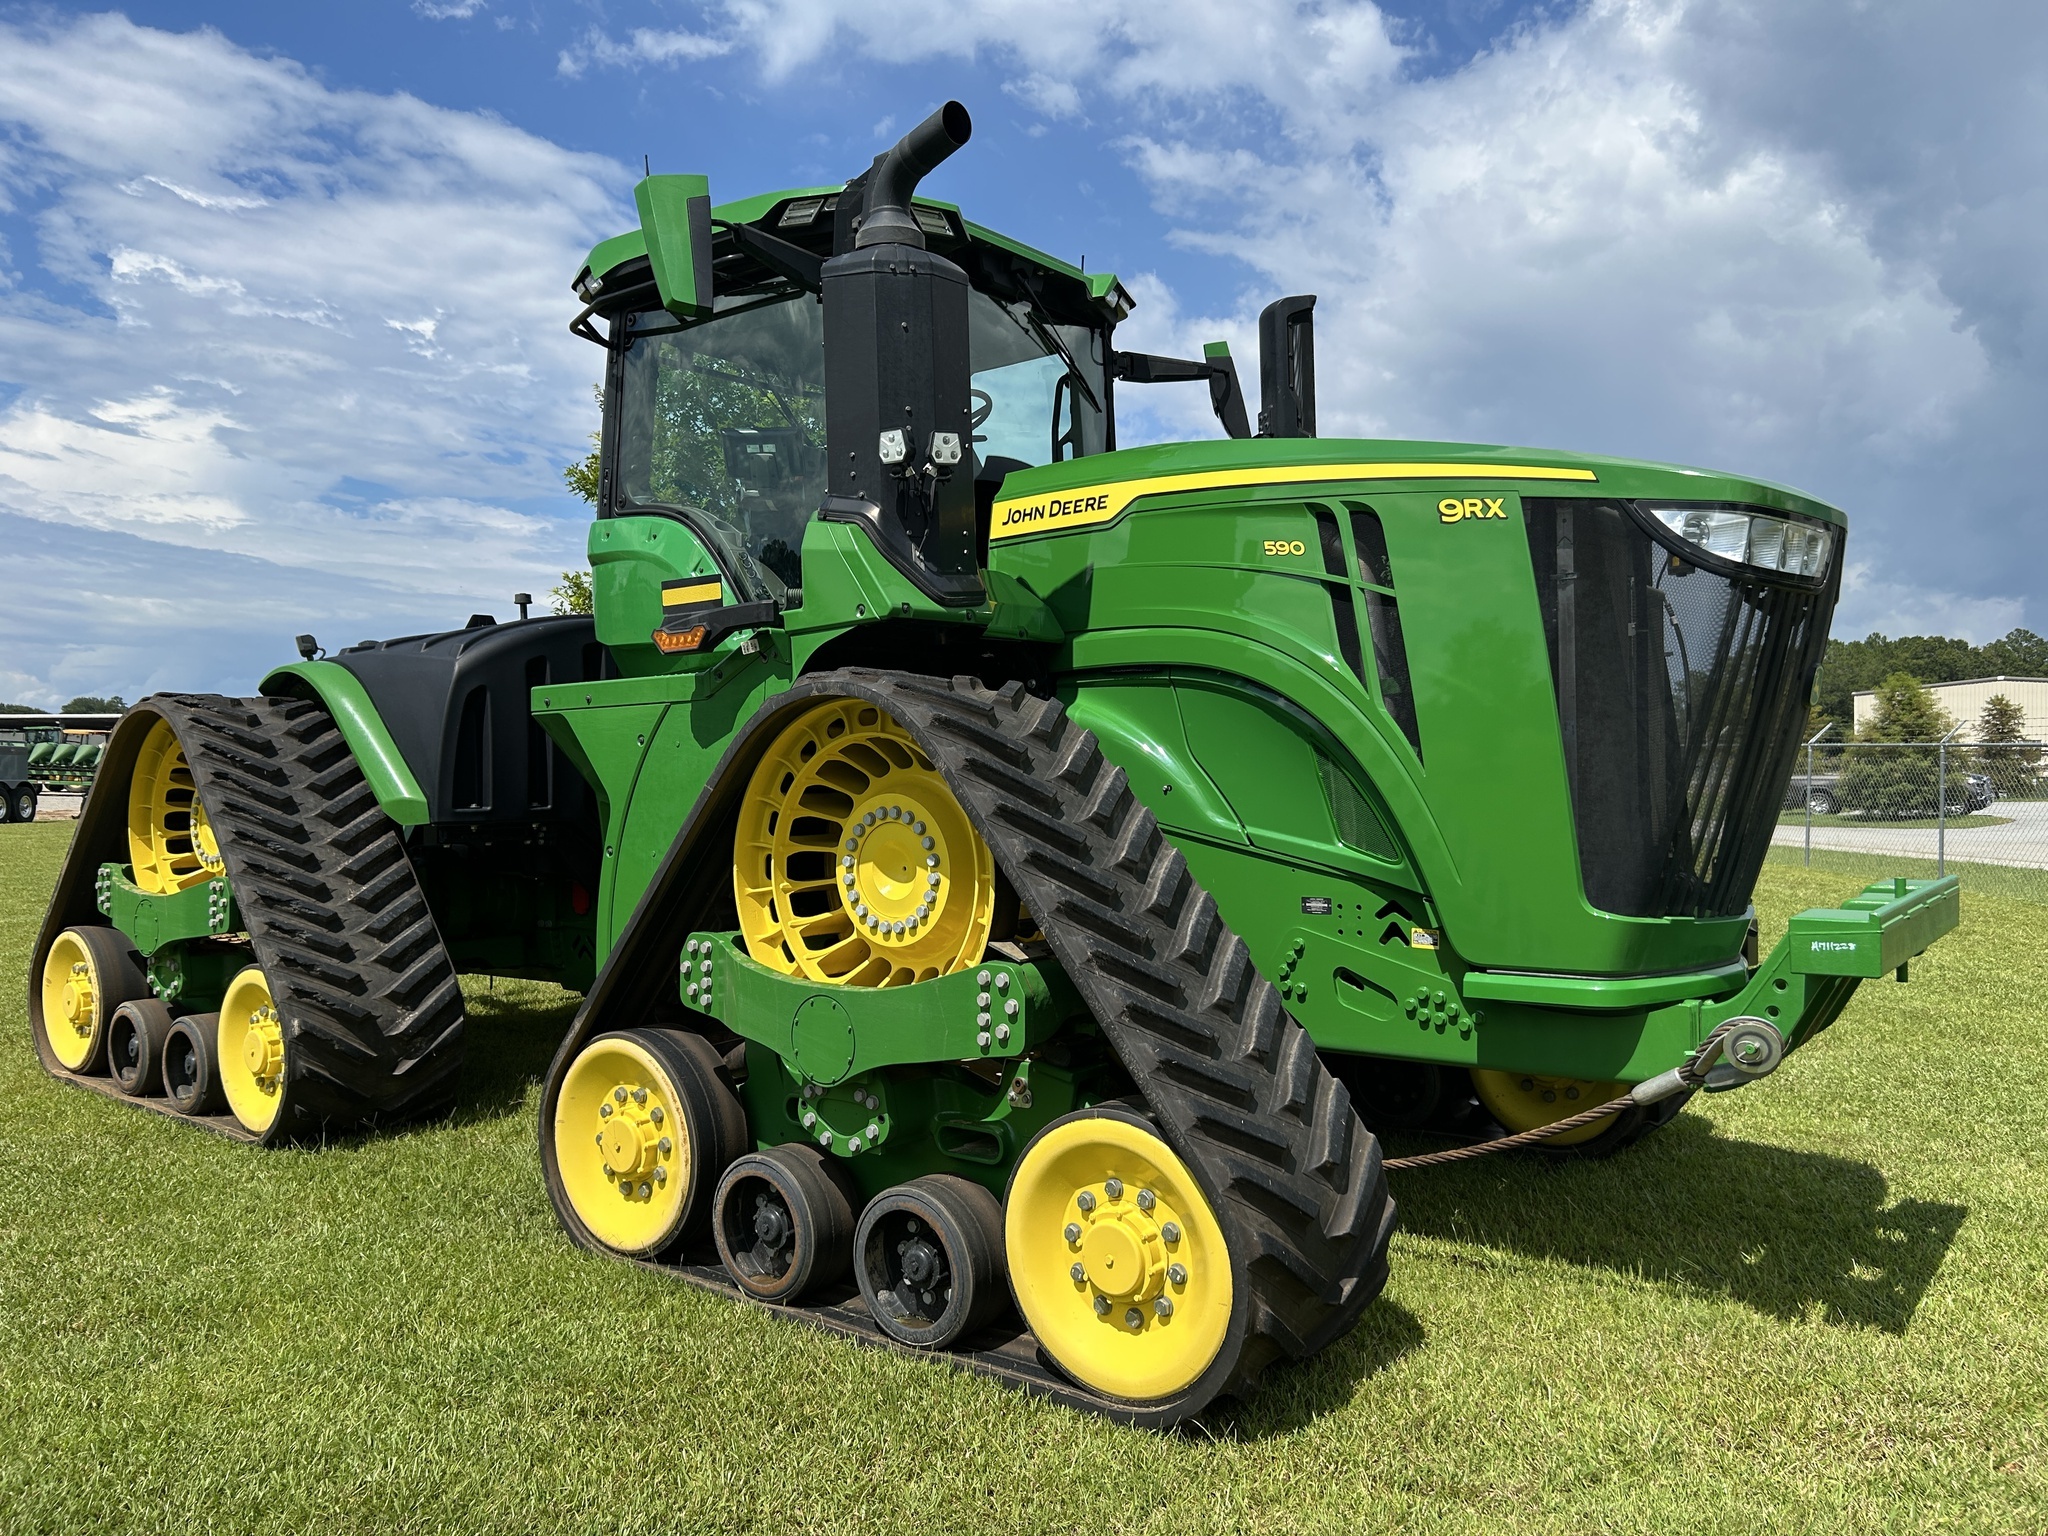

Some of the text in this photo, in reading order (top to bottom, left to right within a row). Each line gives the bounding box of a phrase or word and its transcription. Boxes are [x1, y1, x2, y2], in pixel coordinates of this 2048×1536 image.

[1002, 495, 1109, 526] JOHN DEERE
[1438, 498, 1507, 523] 9RX
[1263, 540, 1306, 556] 590
